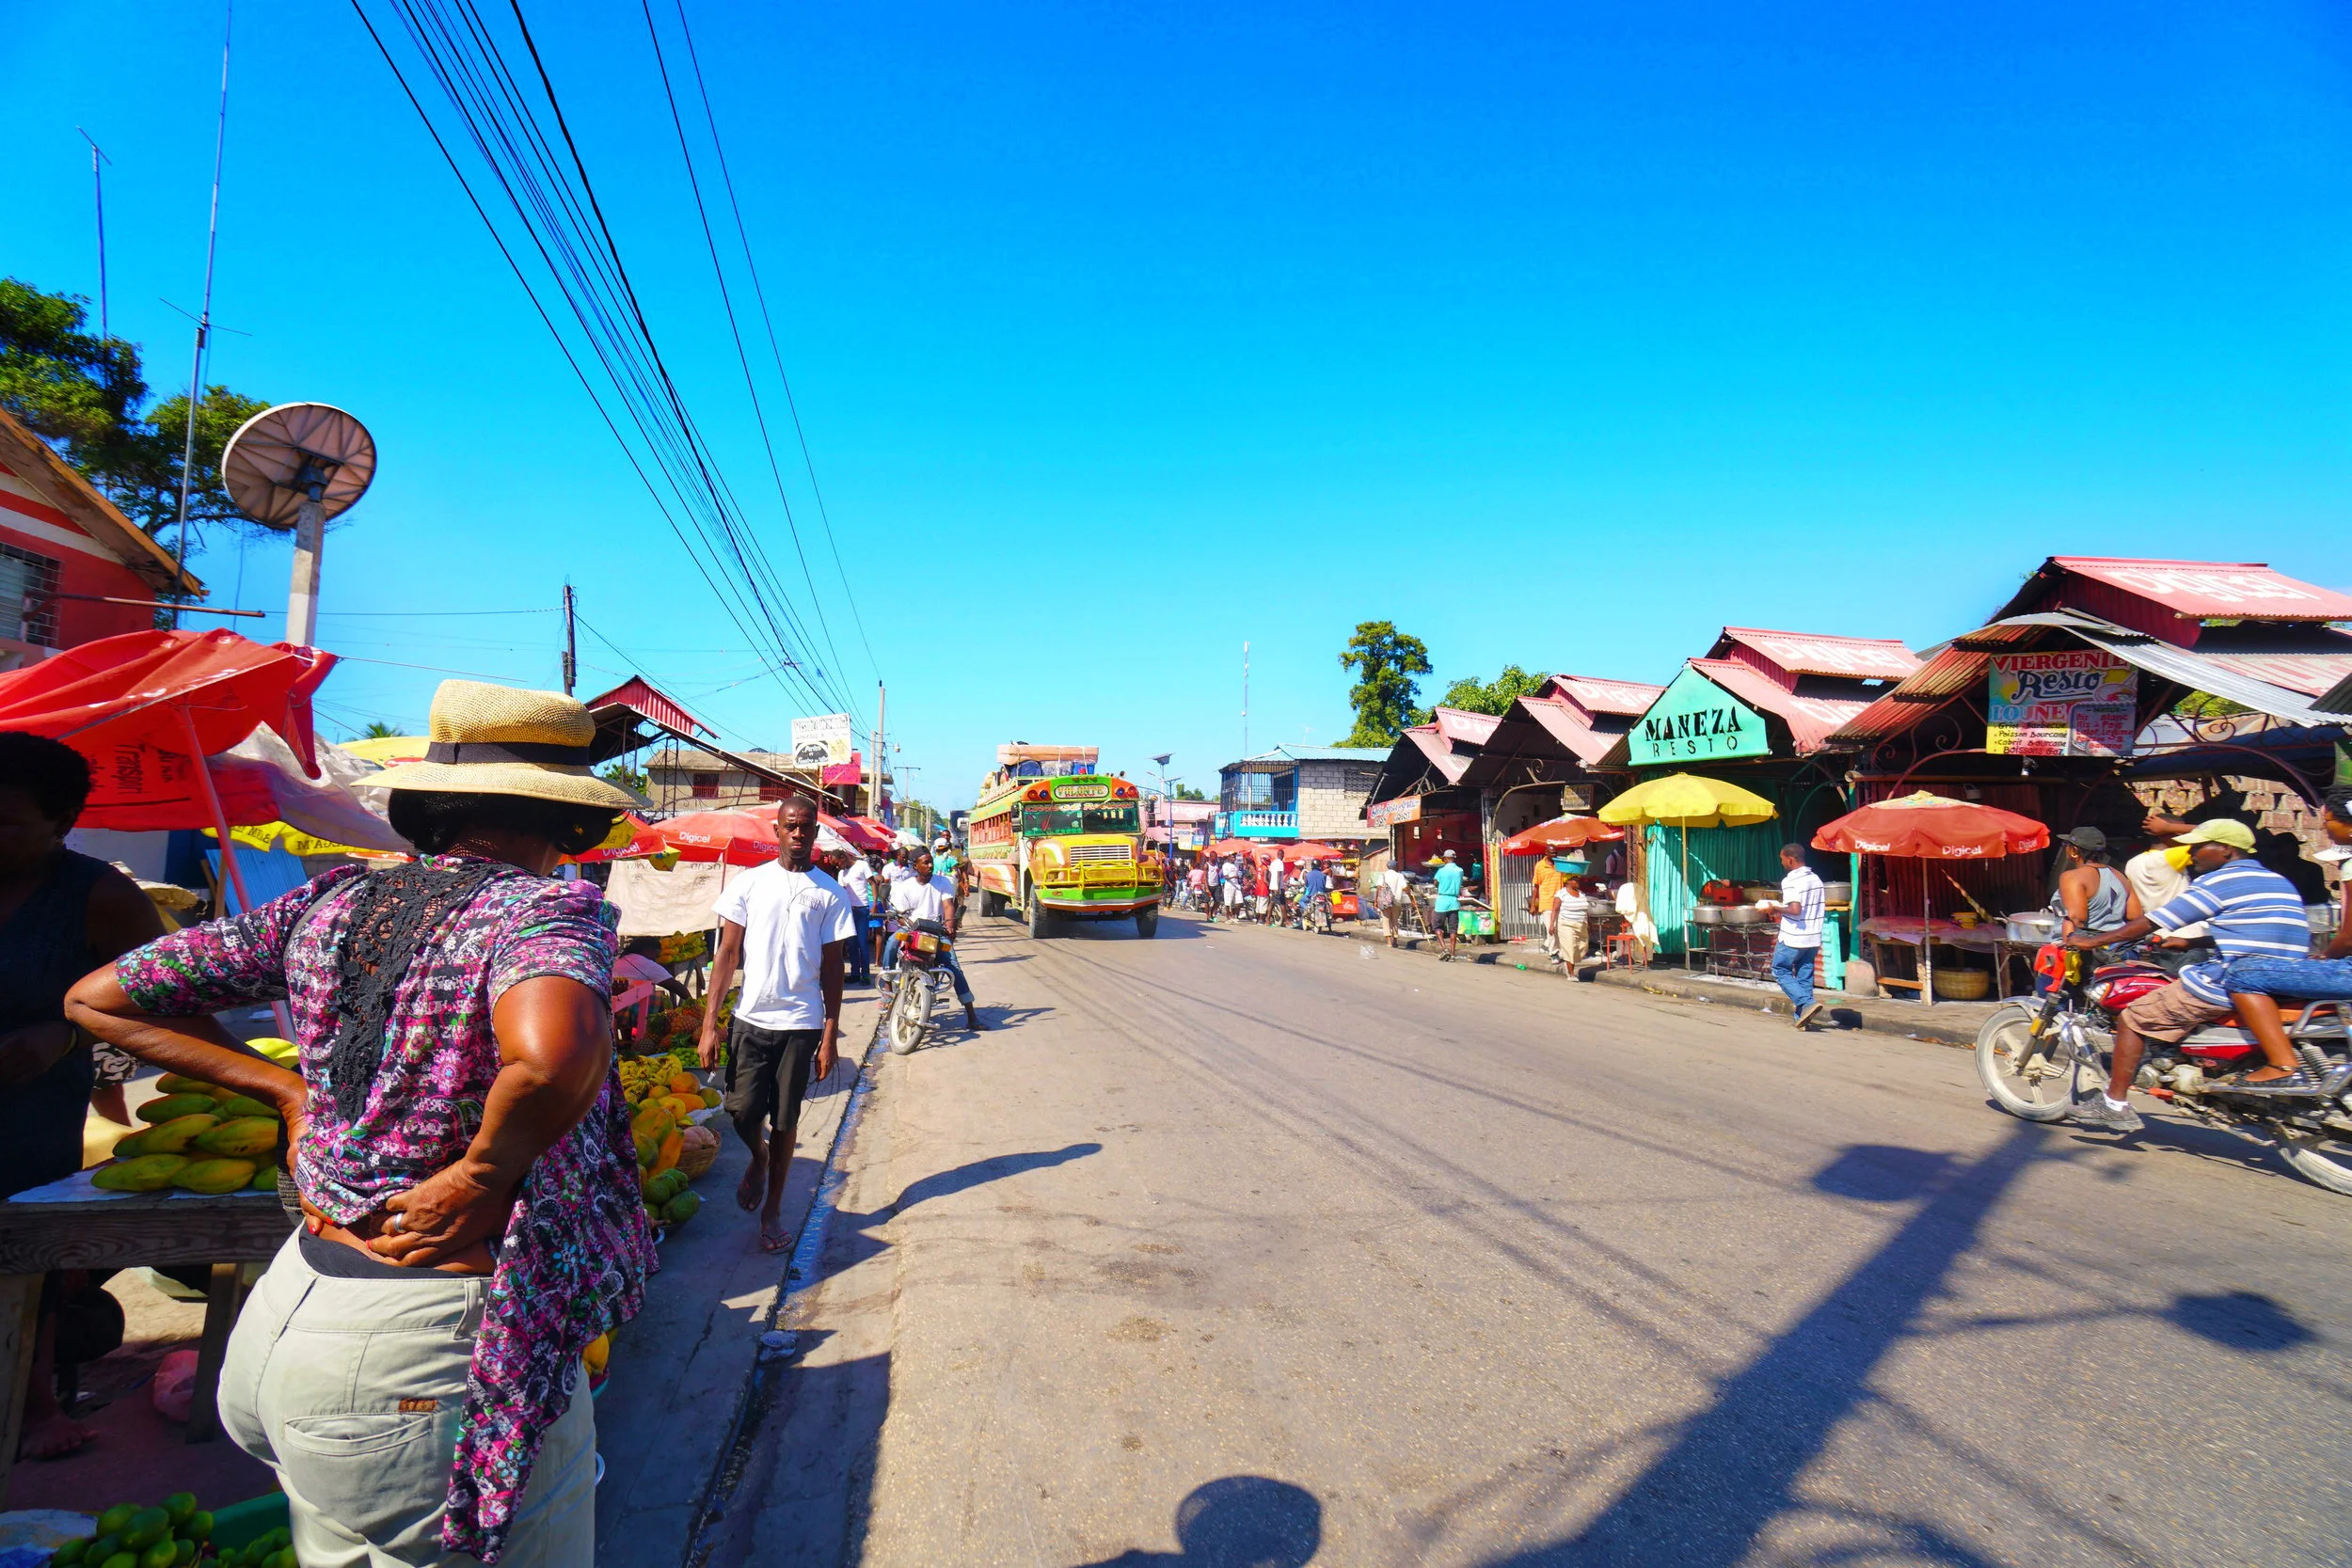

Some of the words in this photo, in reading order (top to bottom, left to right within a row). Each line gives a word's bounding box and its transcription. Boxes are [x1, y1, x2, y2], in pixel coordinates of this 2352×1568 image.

[2011, 670, 2103, 700] Resto
[1645, 705, 1743, 742] MANEZA
[1652, 736, 1738, 757] RESTO
[2004, 744, 2042, 754] Boissons
[679, 831, 710, 844] Digicel
[602, 842, 641, 857] Digicel
[1854, 840, 1891, 852] Digicel
